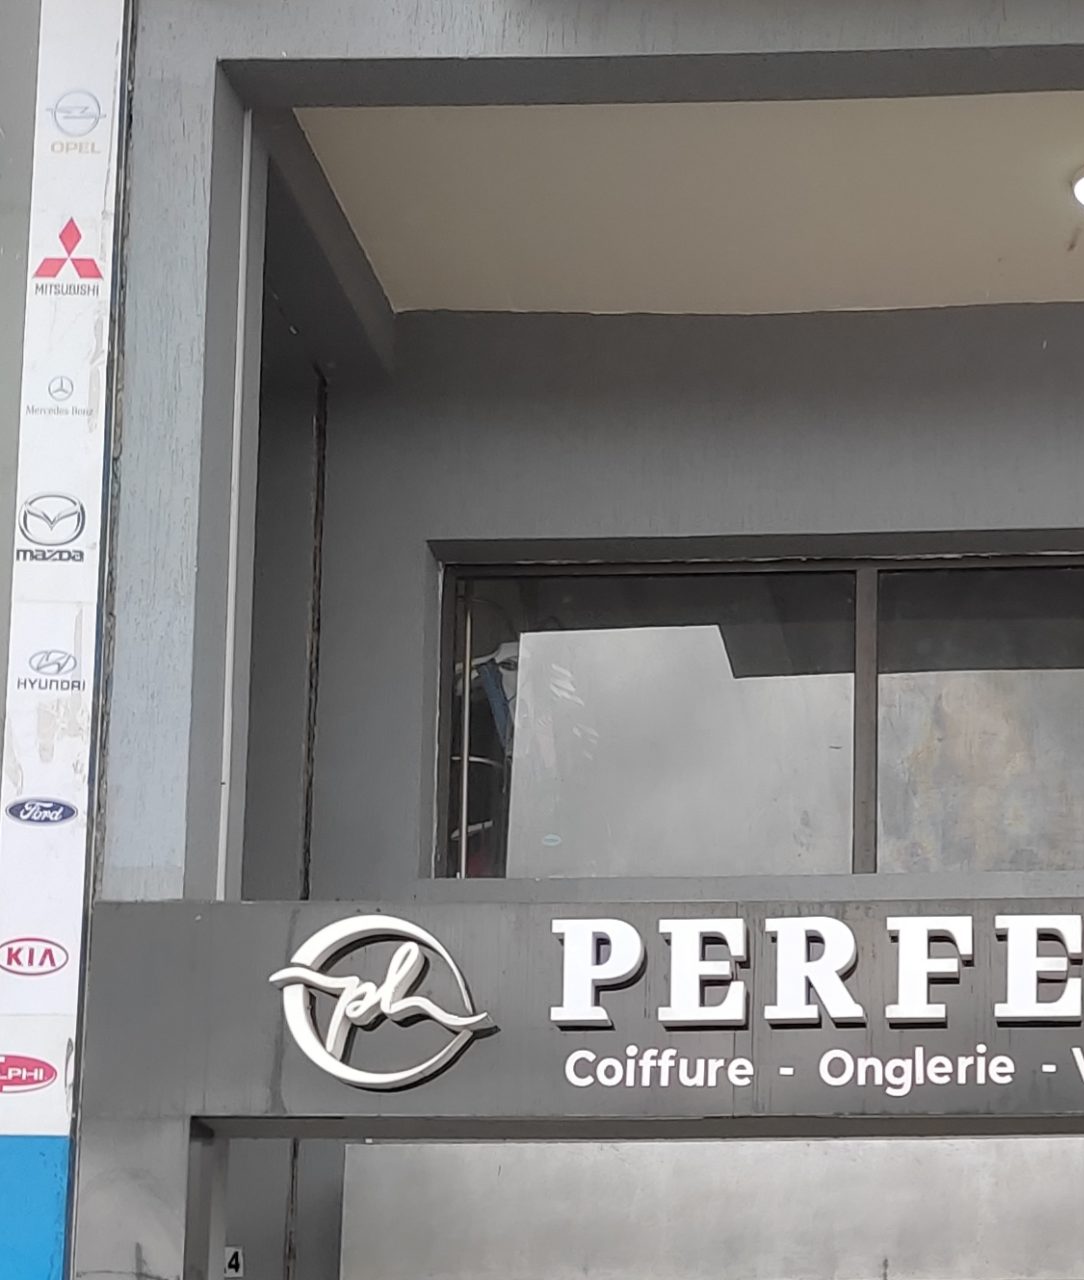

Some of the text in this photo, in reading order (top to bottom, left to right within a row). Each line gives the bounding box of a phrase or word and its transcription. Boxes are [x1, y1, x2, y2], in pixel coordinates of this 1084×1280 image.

[51, 141, 100, 154] OPEL
[34, 282, 100, 297] MITSUBISHI
[17, 678, 86, 691] HYUNDAI
[20, 801, 64, 820] Ford
[7, 948, 56, 966] KIA
[0, 1067, 44, 1081] PHI
[564, 1046, 755, 1088] Coiffure
[818, 1044, 1016, 1097] Onglerie
[224, 1251, 240, 1273] 4
